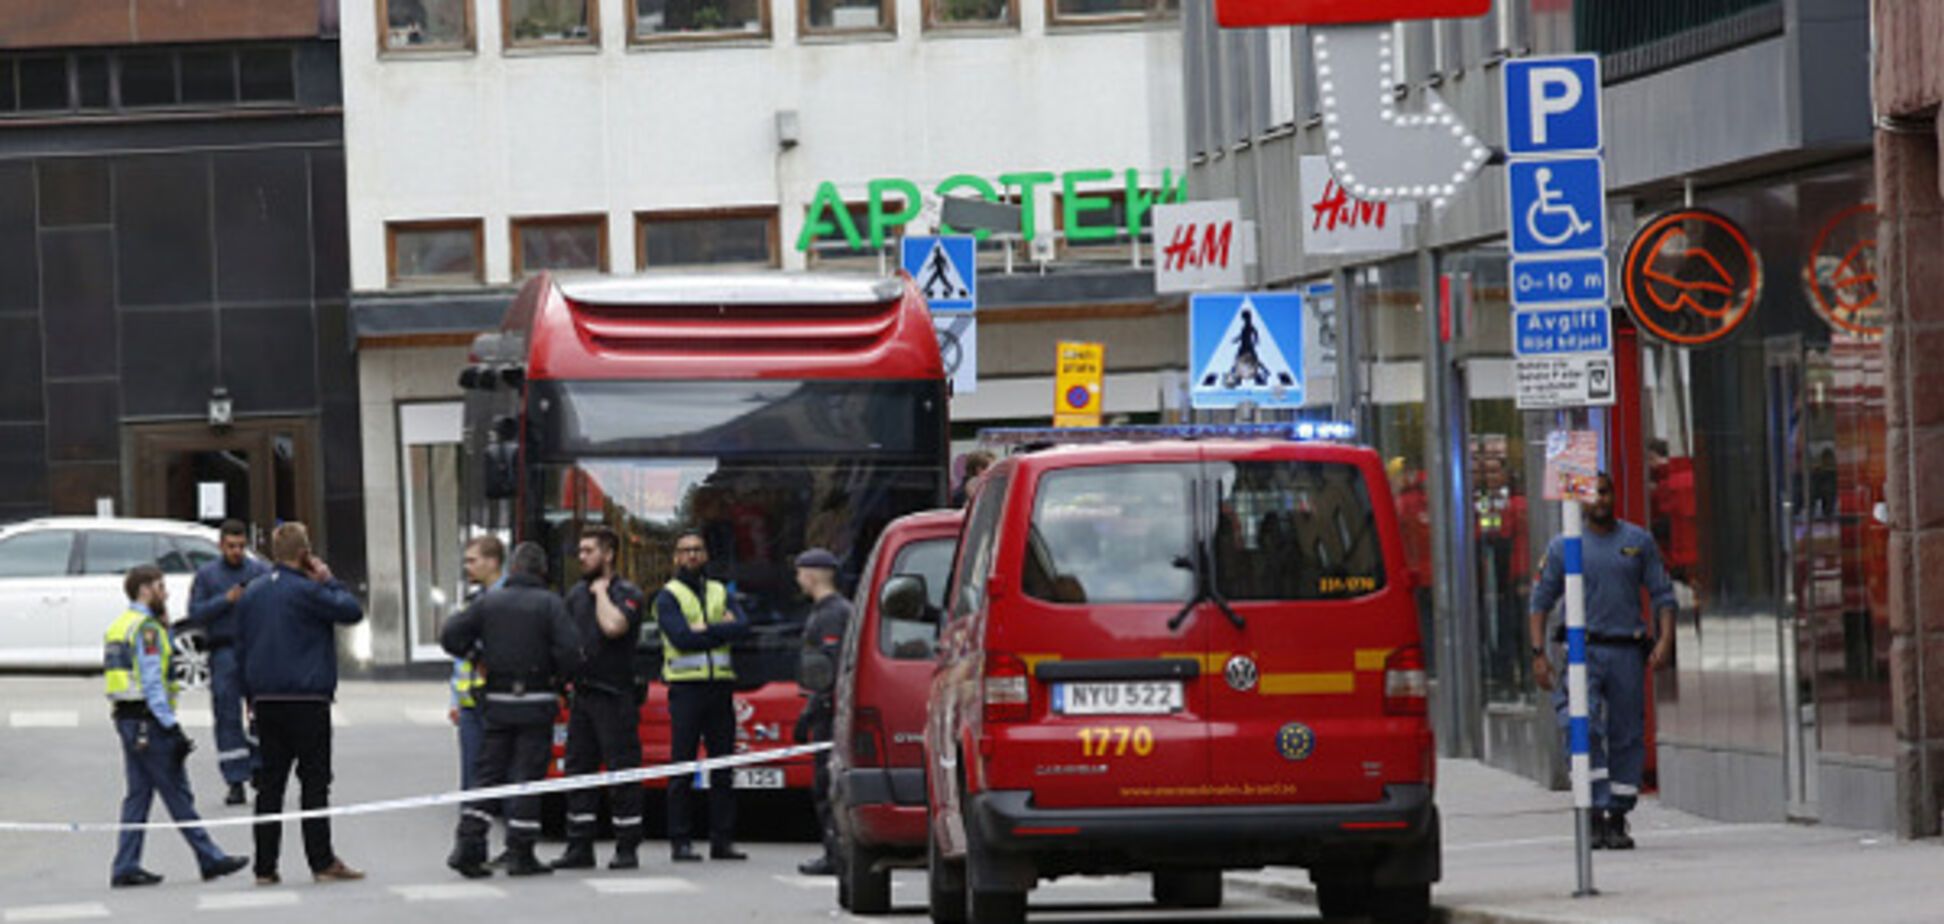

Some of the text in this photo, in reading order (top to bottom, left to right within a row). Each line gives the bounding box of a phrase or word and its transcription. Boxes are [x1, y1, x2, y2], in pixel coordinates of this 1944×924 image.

[1529, 67, 1583, 144] P
[1163, 220, 1233, 272] H&M
[1517, 272, 1602, 292] 0-10 m
[1072, 685, 1171, 706] NYU 522
[1076, 726, 1154, 757] 1770
